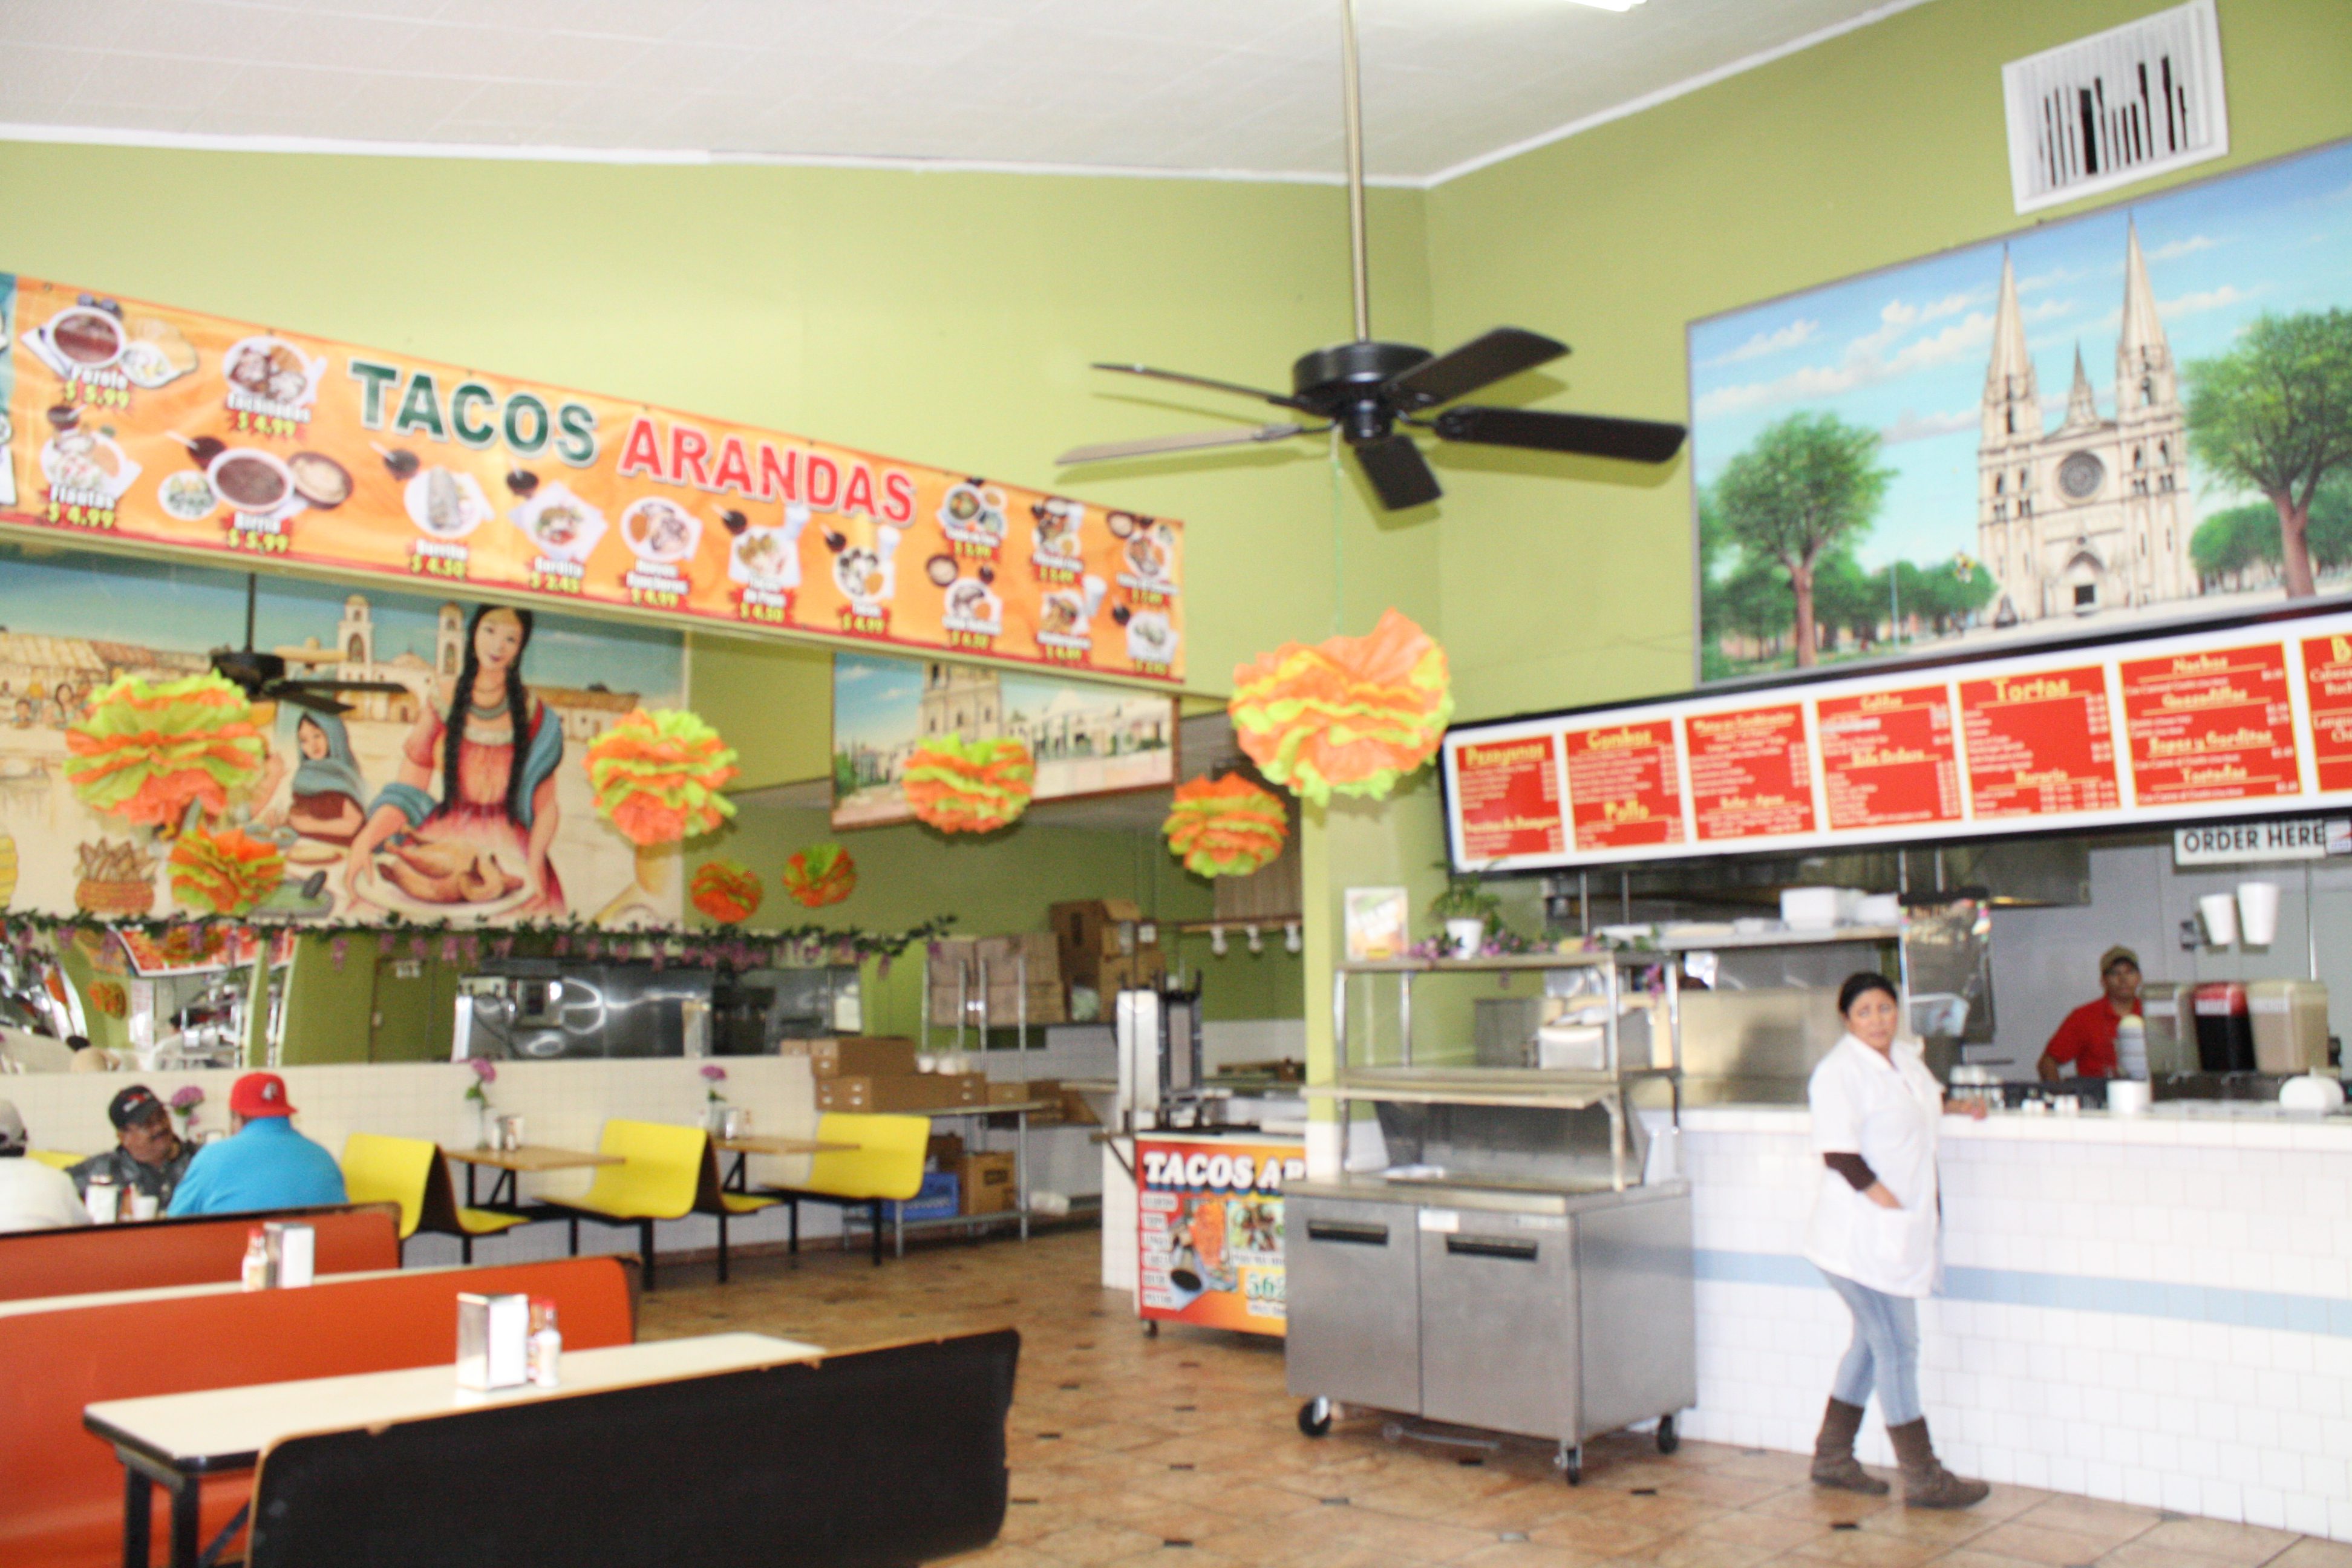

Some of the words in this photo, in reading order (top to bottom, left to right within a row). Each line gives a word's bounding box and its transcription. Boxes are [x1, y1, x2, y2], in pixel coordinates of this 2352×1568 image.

[348, 358, 600, 469] TACOS
[616, 416, 917, 528] ARANDAS
[1991, 678, 2069, 702] Tortas
[2184, 829, 2258, 852] ORDER
[2267, 825, 2324, 847] HERE
[1143, 1151, 1255, 1191] TACOS
